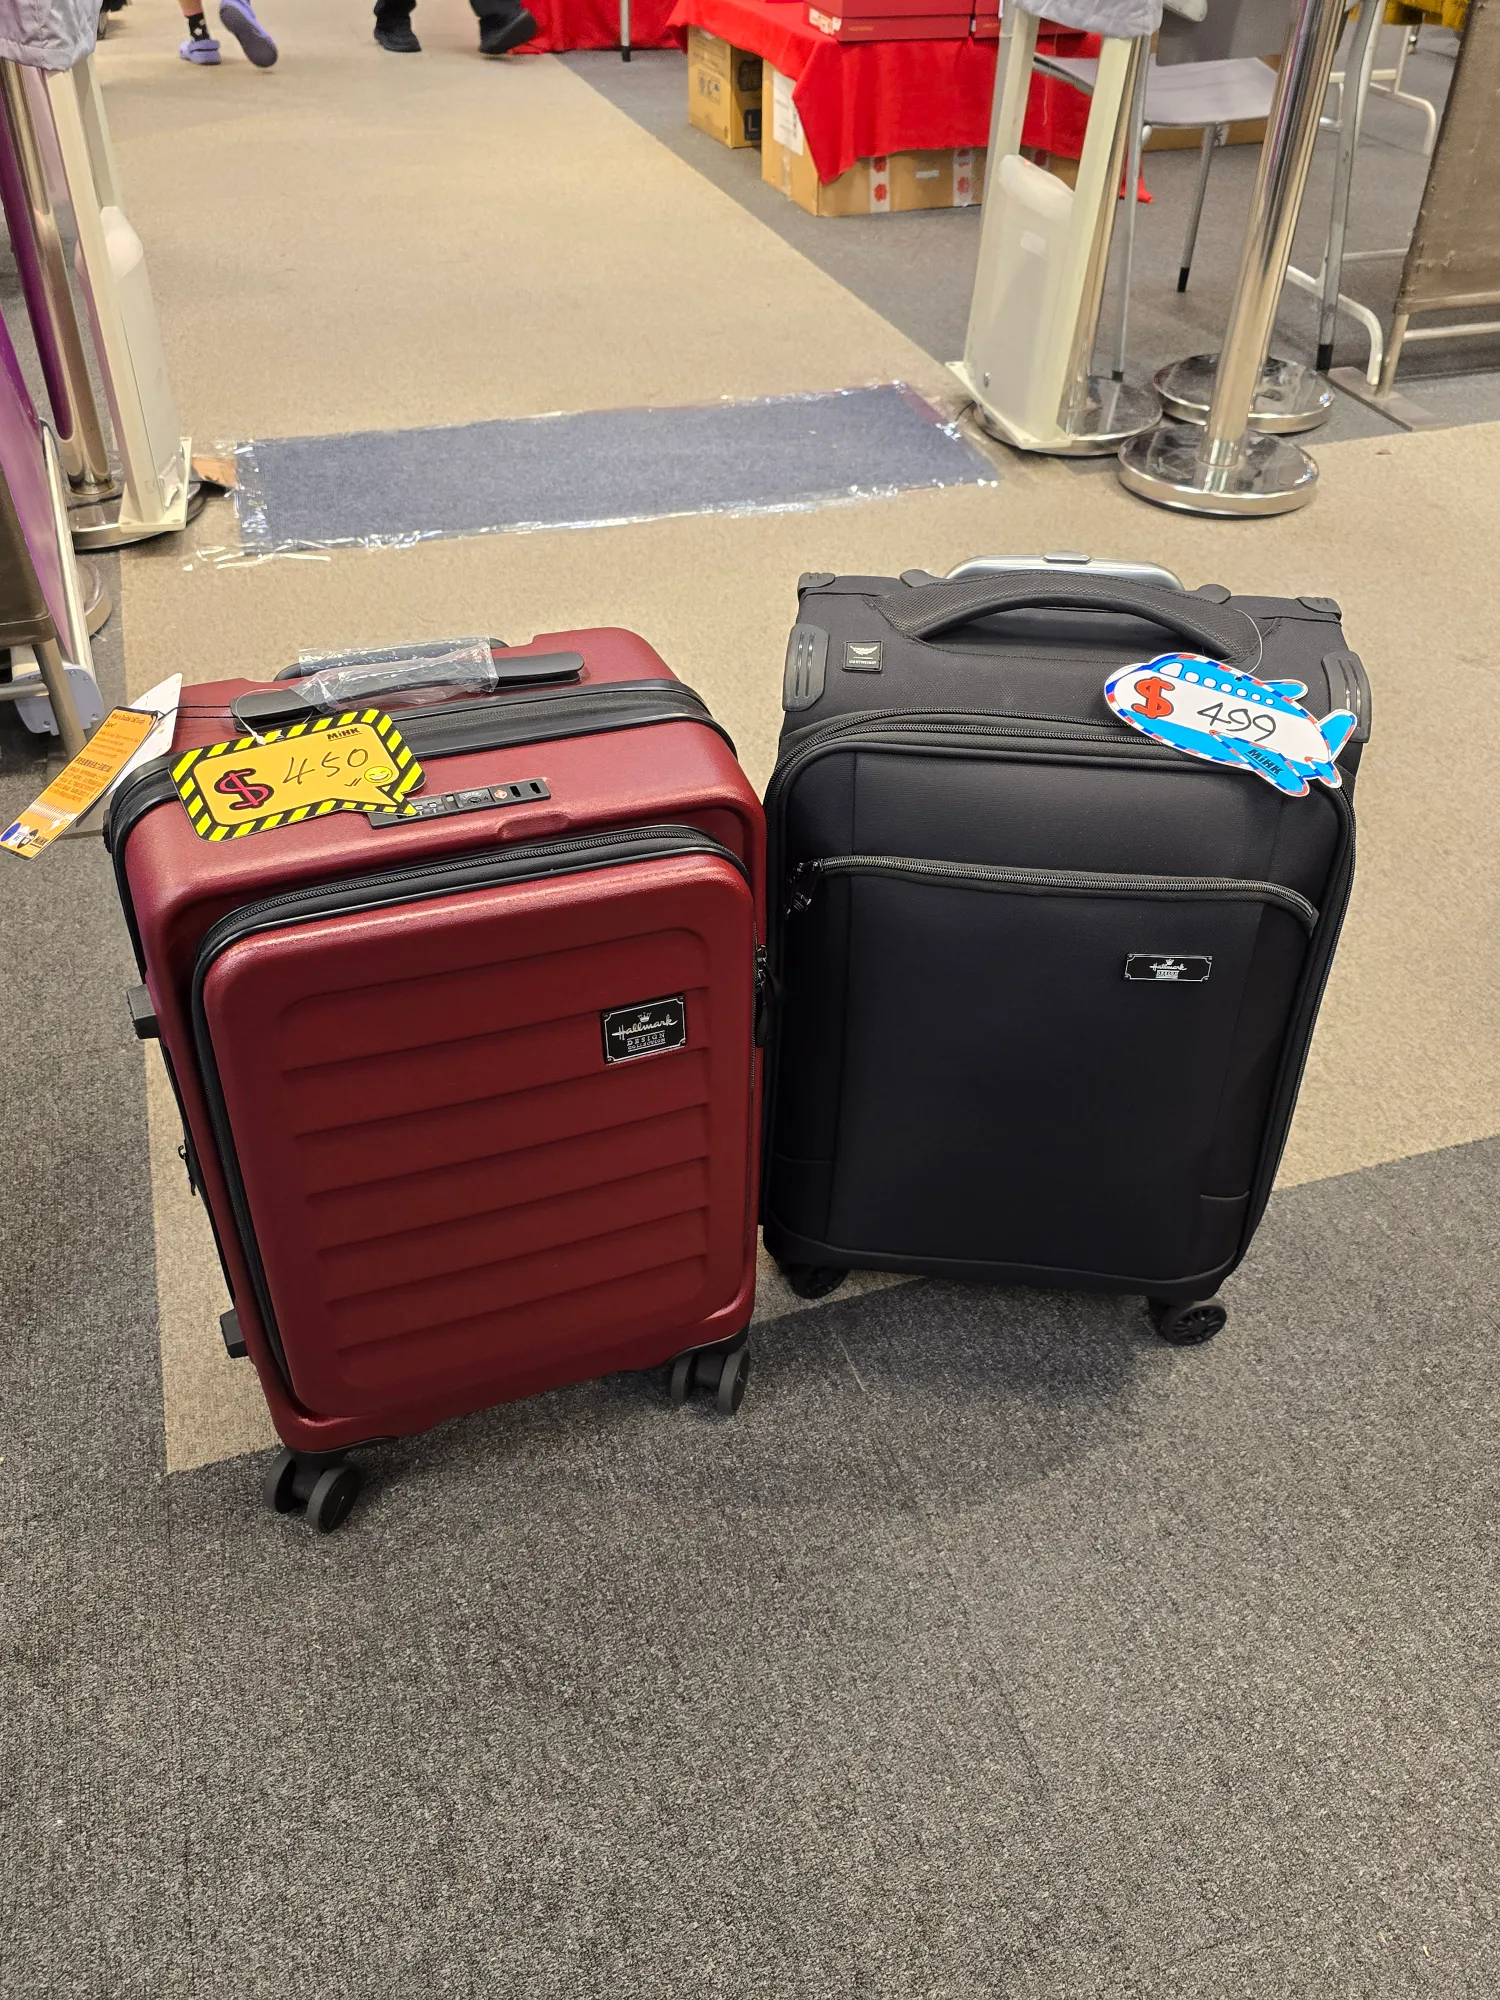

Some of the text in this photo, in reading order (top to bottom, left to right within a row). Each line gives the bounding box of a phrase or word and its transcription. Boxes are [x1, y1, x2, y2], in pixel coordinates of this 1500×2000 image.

[1131, 676, 1277, 742] $ 499
[327, 726, 360, 741] MiHK
[1249, 748, 1285, 777] MiHK
[213, 748, 369, 811] $ 450
[611, 1013, 679, 1041] Hallmark
[626, 1032, 666, 1047] DESIGN
